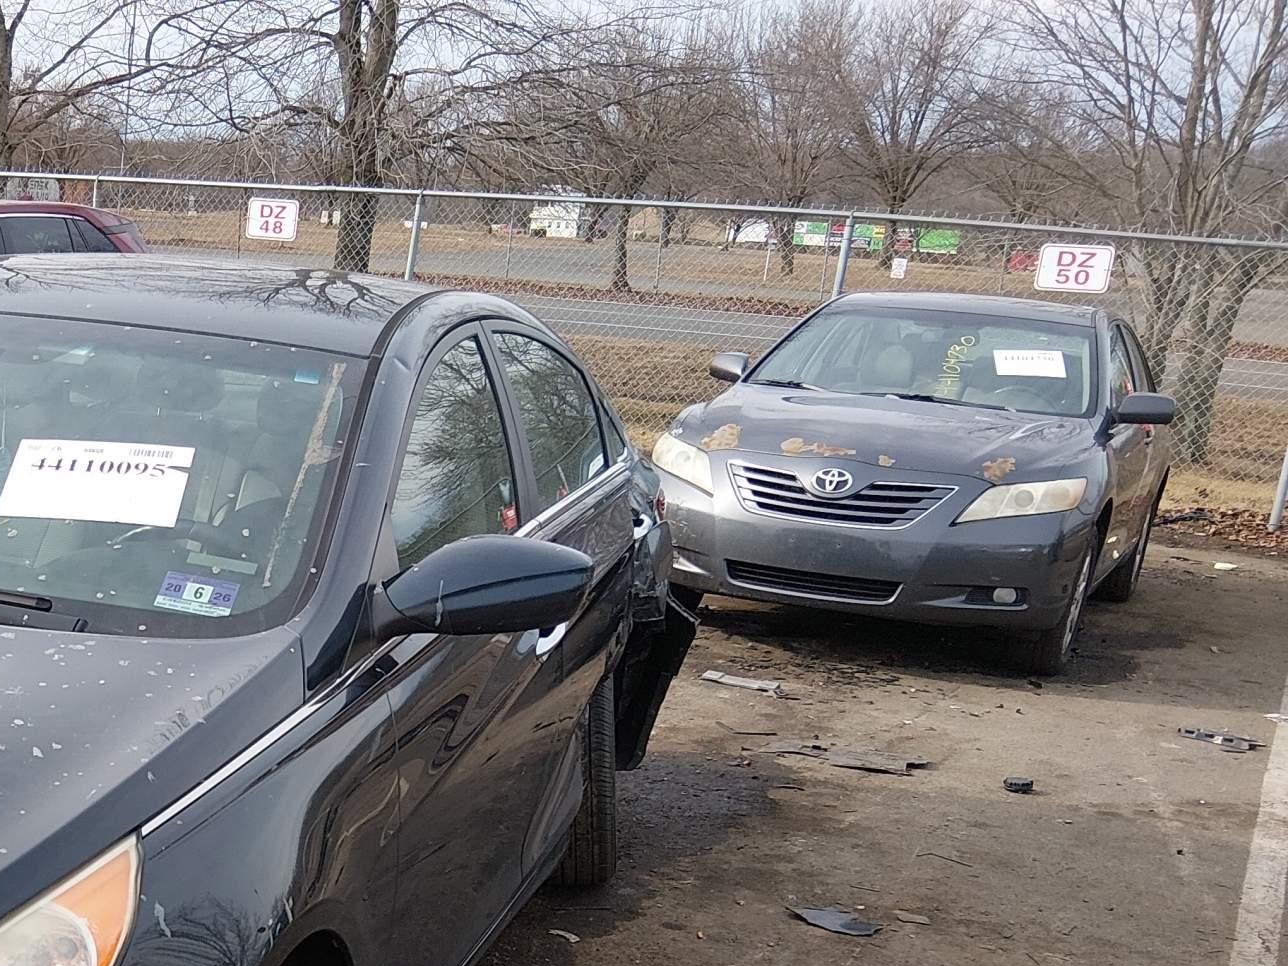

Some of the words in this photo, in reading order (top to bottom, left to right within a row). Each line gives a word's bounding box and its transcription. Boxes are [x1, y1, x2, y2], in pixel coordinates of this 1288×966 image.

[260, 204, 287, 219] DZ
[259, 220, 283, 234] 48
[1056, 250, 1098, 268] DZ
[1055, 268, 1090, 285] 50
[31, 457, 167, 478] 44110095
[165, 582, 183, 593] 20
[193, 586, 205, 600] 6
[213, 592, 232, 603] 26
